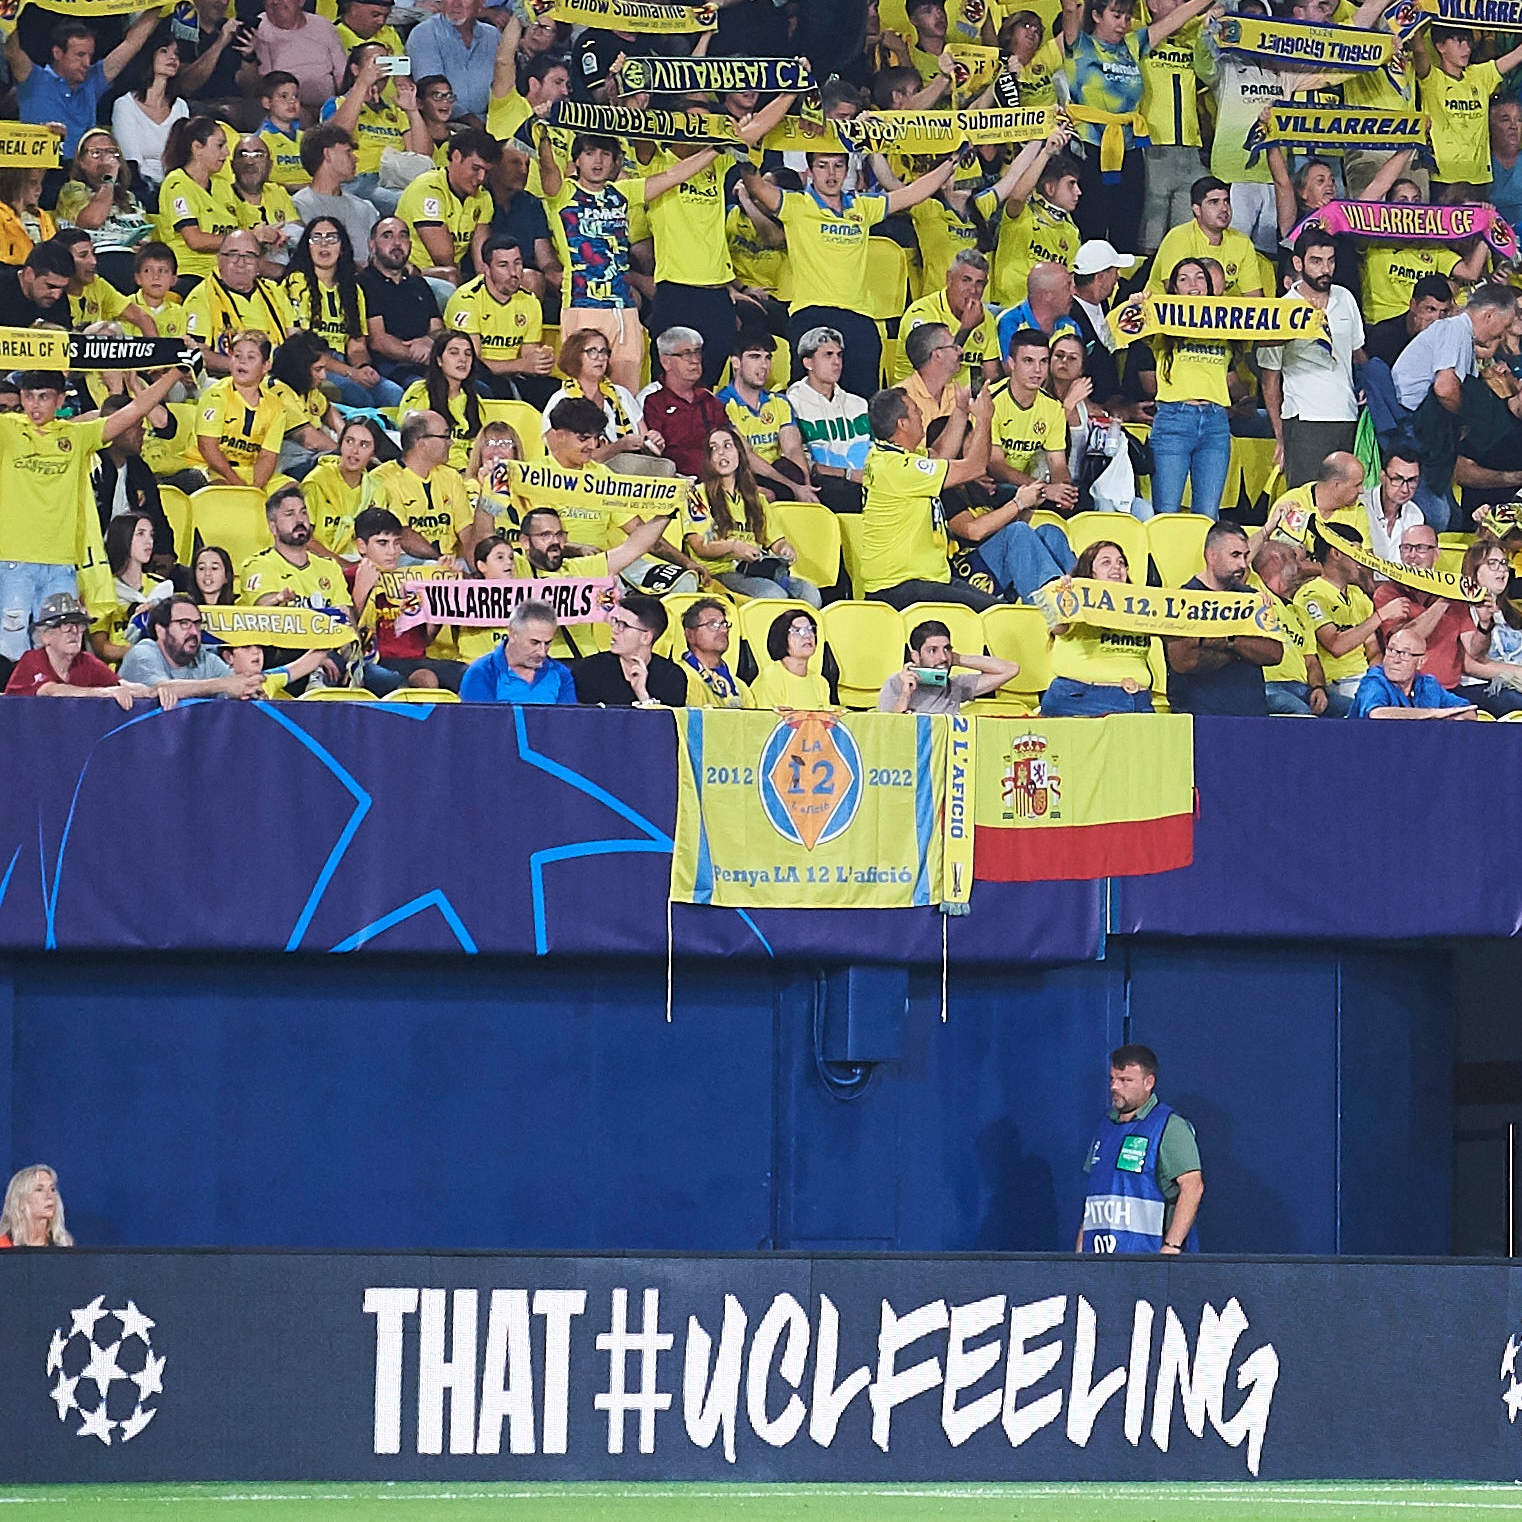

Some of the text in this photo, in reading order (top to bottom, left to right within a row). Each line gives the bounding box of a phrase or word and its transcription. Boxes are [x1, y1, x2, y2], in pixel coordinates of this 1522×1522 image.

[958, 109, 1045, 132] Submarine
[1277, 116, 1420, 138] VILLARREAL
[1341, 204, 1472, 235] VILLARREAL CF
[1154, 303, 1313, 332] VILLARREAL CF
[38, 340, 56, 357] CF
[62, 342, 78, 358] VS
[83, 341, 154, 358] JUVENTUS
[520, 465, 676, 501] Yellow Submarine
[1082, 587, 1255, 621] LA 12. L'afició
[801, 739, 822, 753] LA
[706, 766, 753, 785] 2012
[789, 758, 836, 795] 12
[870, 769, 914, 786] 2022
[714, 864, 914, 887] Penya LA 12 L'afició
[362, 1287, 1280, 1477] THAT #UCLFEELING
